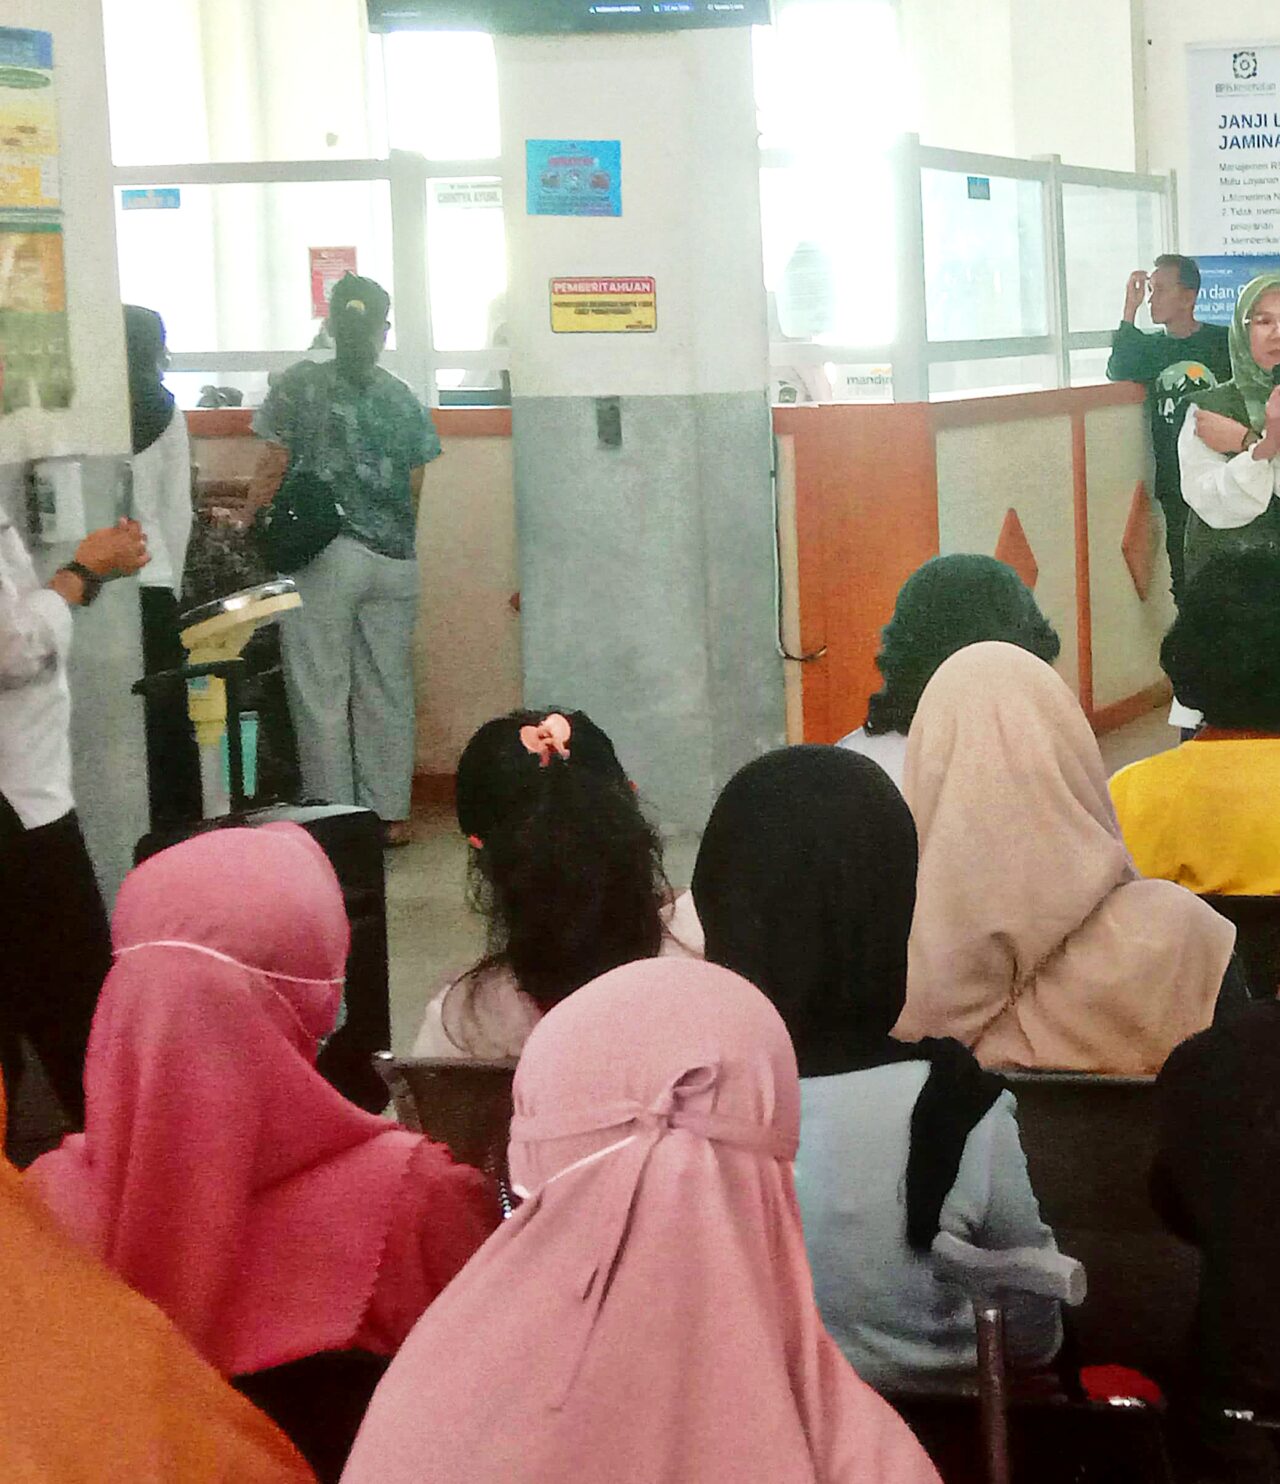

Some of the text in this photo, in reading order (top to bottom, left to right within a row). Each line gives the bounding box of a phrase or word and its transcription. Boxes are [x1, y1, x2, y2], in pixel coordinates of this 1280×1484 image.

[1218, 113, 1267, 130] JANJI
[553, 282, 651, 294] PEMBERITAHUAN
[1209, 284, 1235, 299] dan
